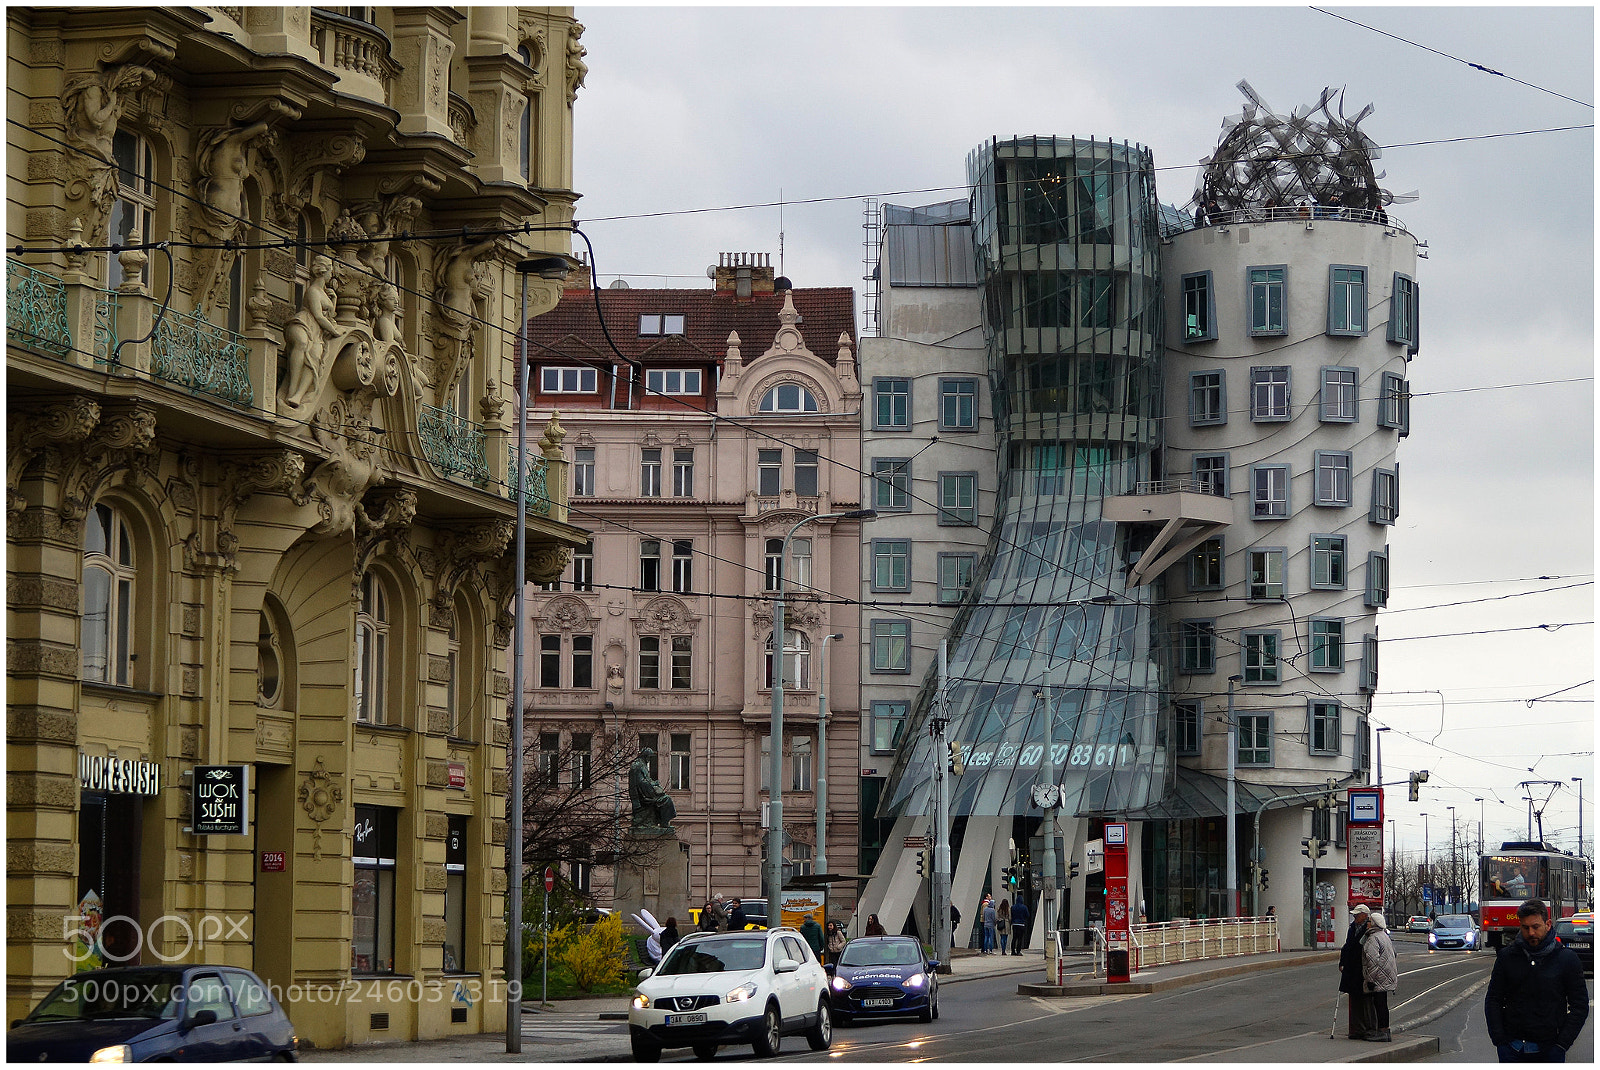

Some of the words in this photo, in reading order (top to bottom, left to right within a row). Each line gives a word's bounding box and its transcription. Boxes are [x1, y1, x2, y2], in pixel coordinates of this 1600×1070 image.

[1070, 744, 1092, 766] 83
[199, 783, 239, 798] WOK
[201, 803, 236, 818] SUSHI
[264, 853, 283, 862] 2014
